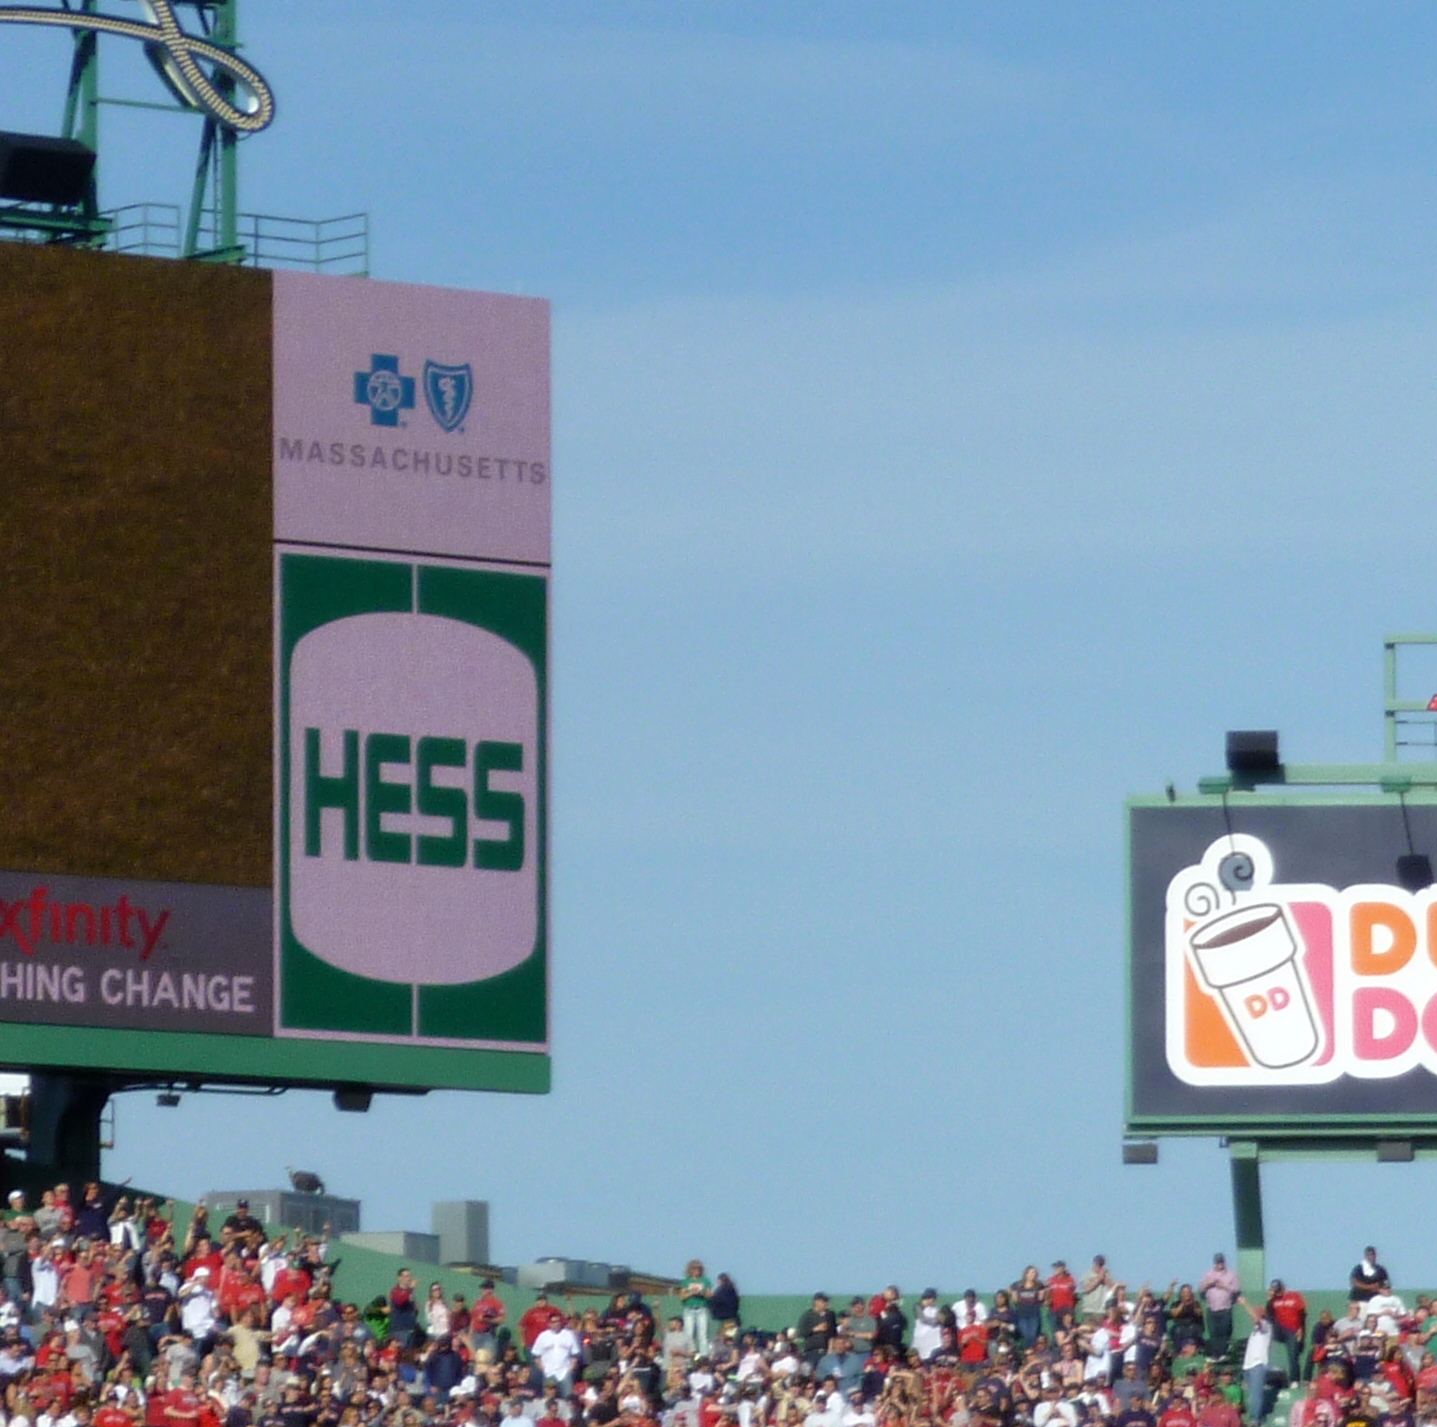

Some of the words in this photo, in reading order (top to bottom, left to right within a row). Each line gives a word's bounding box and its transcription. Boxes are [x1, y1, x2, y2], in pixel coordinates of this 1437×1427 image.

[279, 436, 548, 486] MASSACHUSETTS
[303, 726, 527, 871] HESS
[101, 968, 256, 1013] CHANGE
